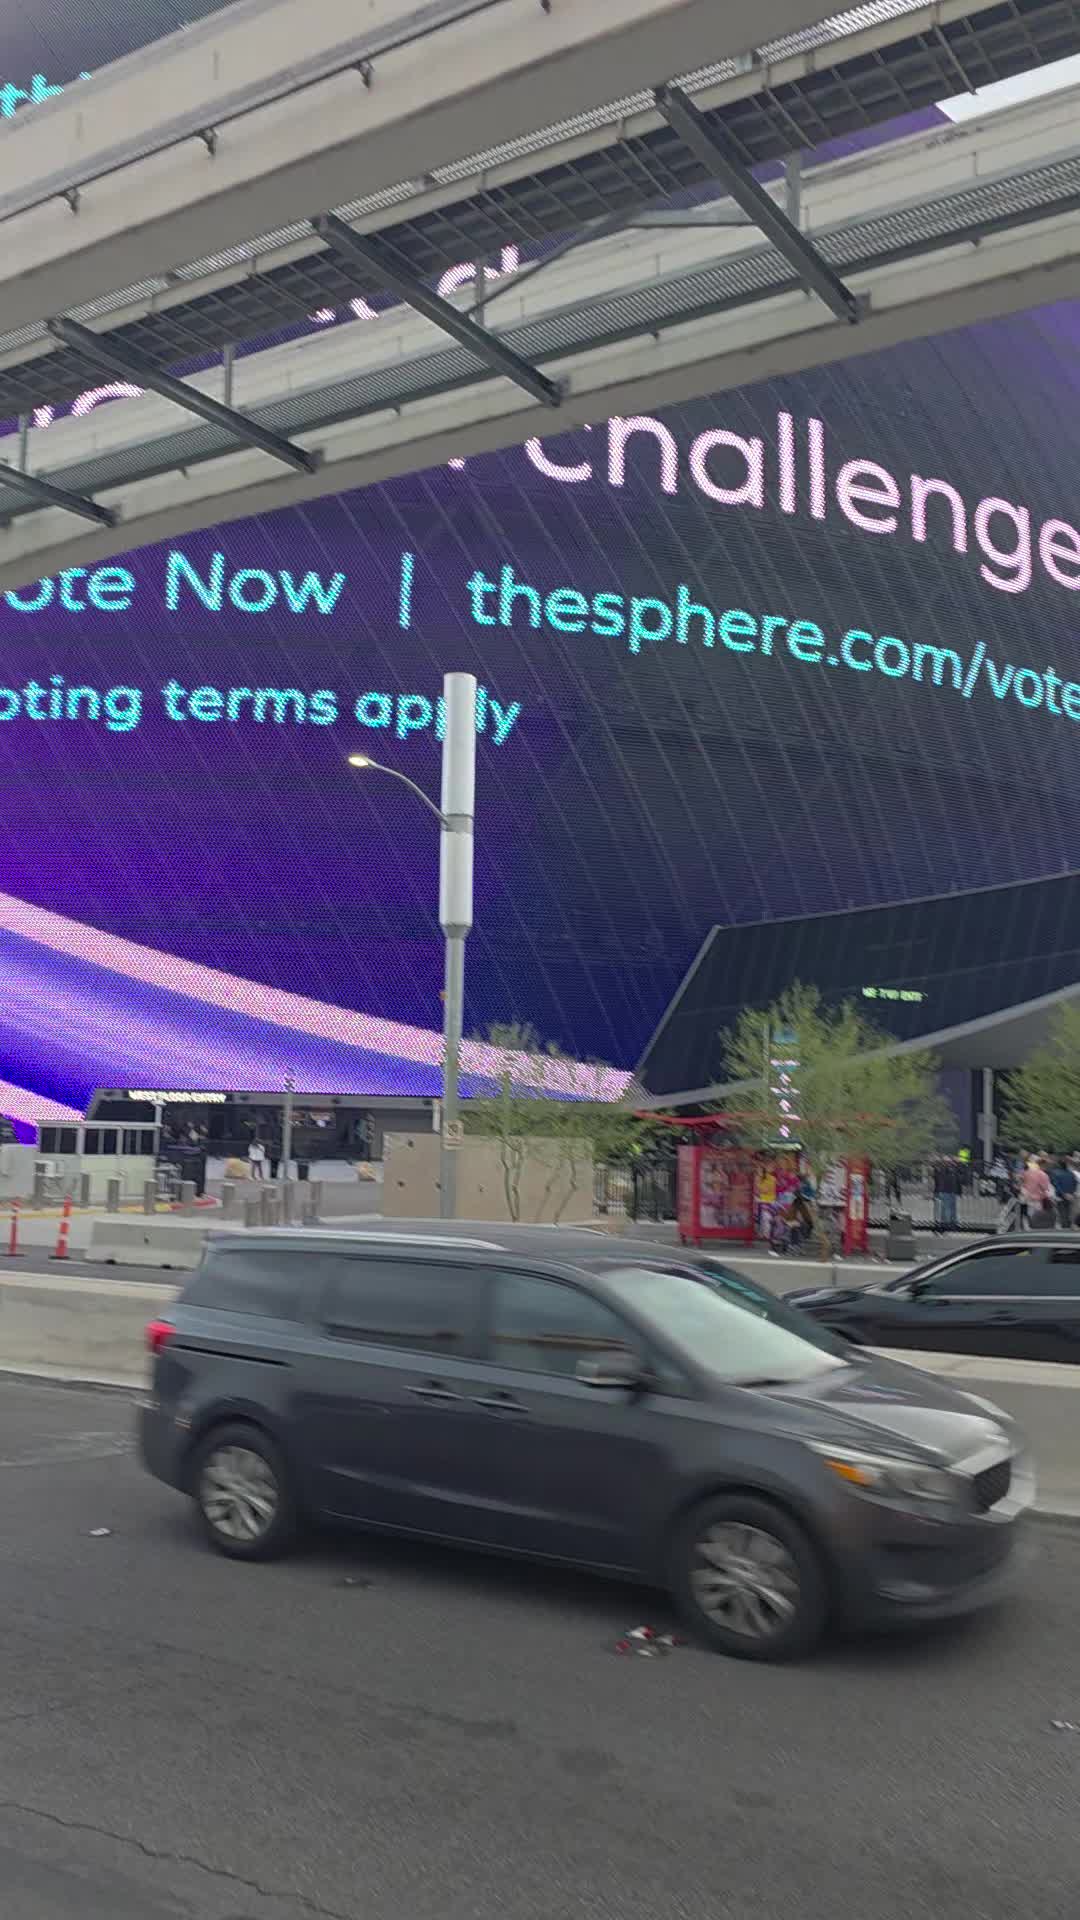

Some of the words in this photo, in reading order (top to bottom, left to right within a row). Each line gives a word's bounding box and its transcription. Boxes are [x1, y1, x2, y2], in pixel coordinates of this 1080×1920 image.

[165, 550, 346, 615] Now
[466, 564, 1080, 721] thesphere.com/vote
[162, 679, 339, 725] terms
